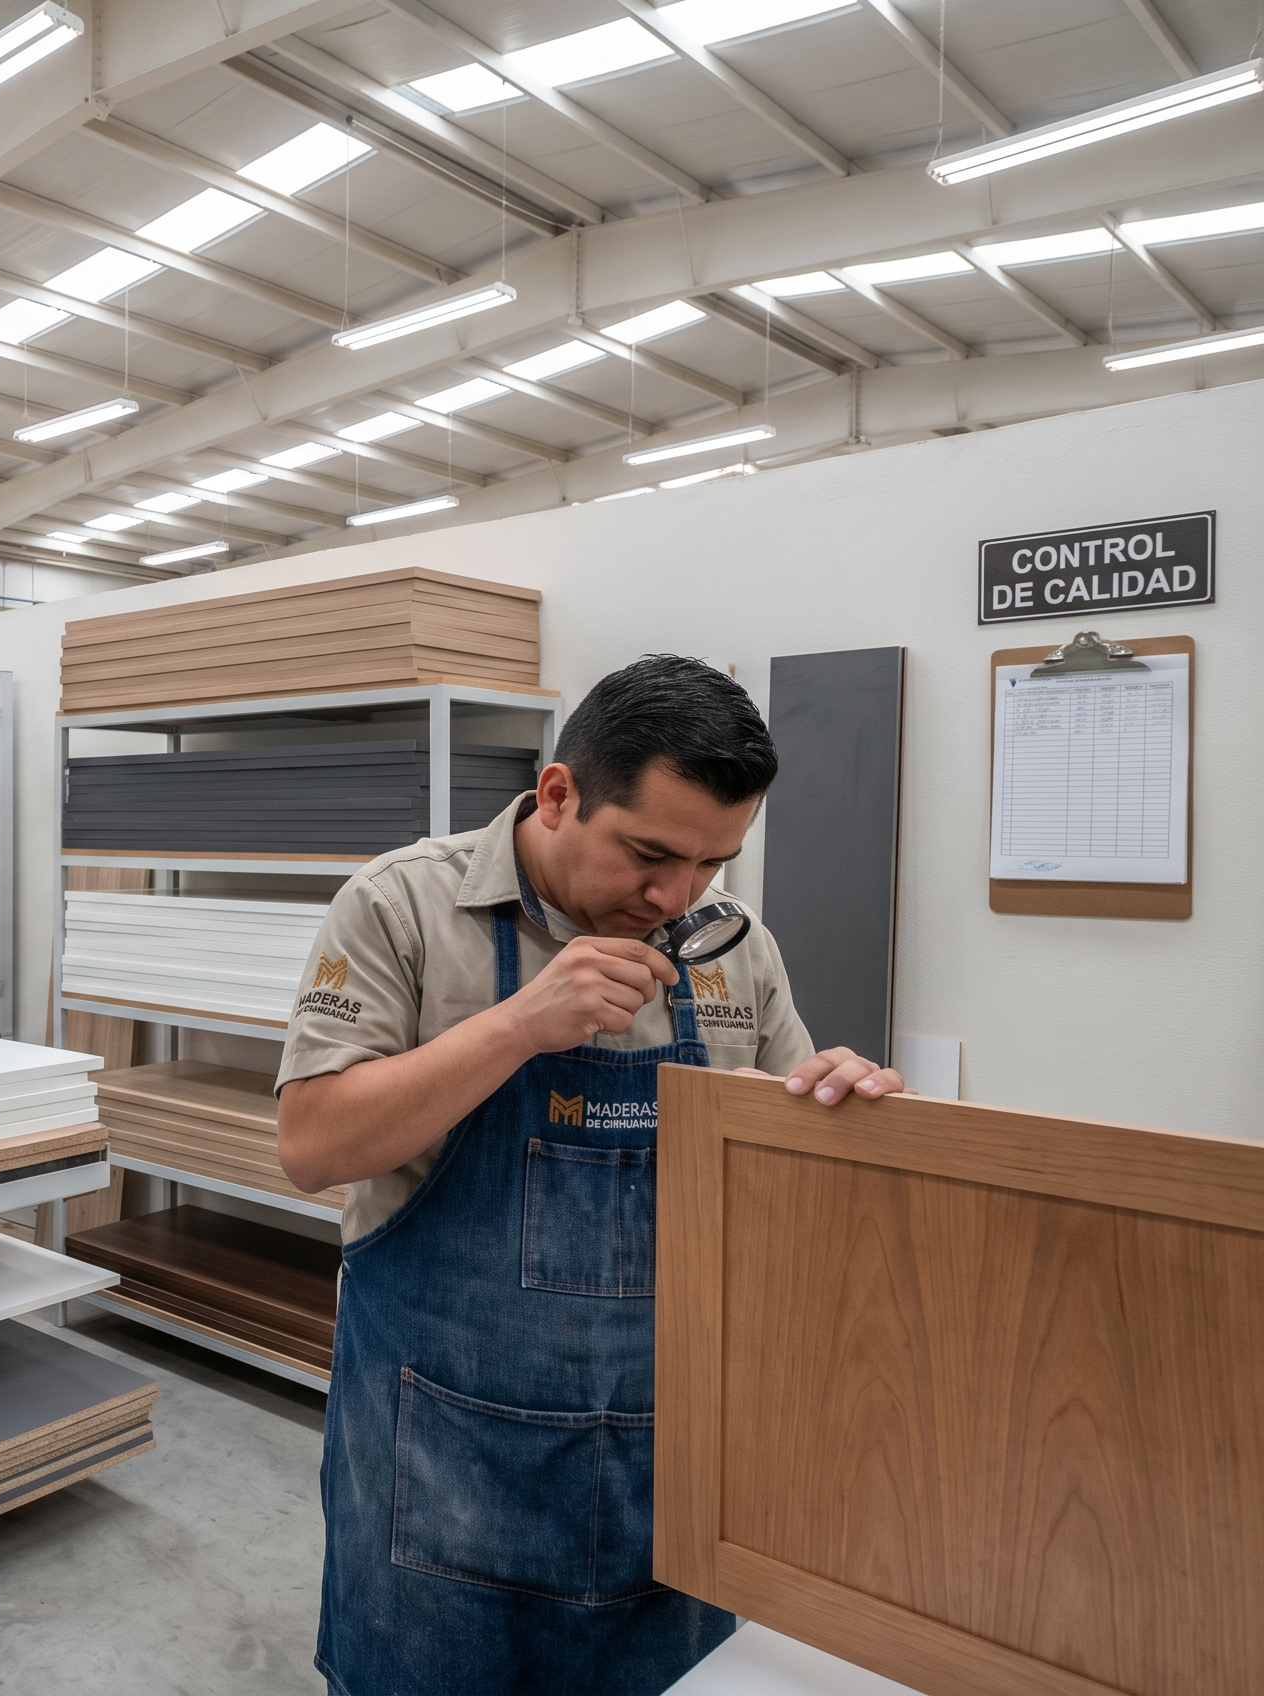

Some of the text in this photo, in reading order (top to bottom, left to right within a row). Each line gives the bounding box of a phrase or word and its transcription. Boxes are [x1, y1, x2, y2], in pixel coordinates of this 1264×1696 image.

[1012, 532, 1175, 574] CONTROL
[992, 565, 1196, 610] DE CALIDAD
[696, 1004, 754, 1020] ADERAS
[586, 1119, 601, 1128] DE
